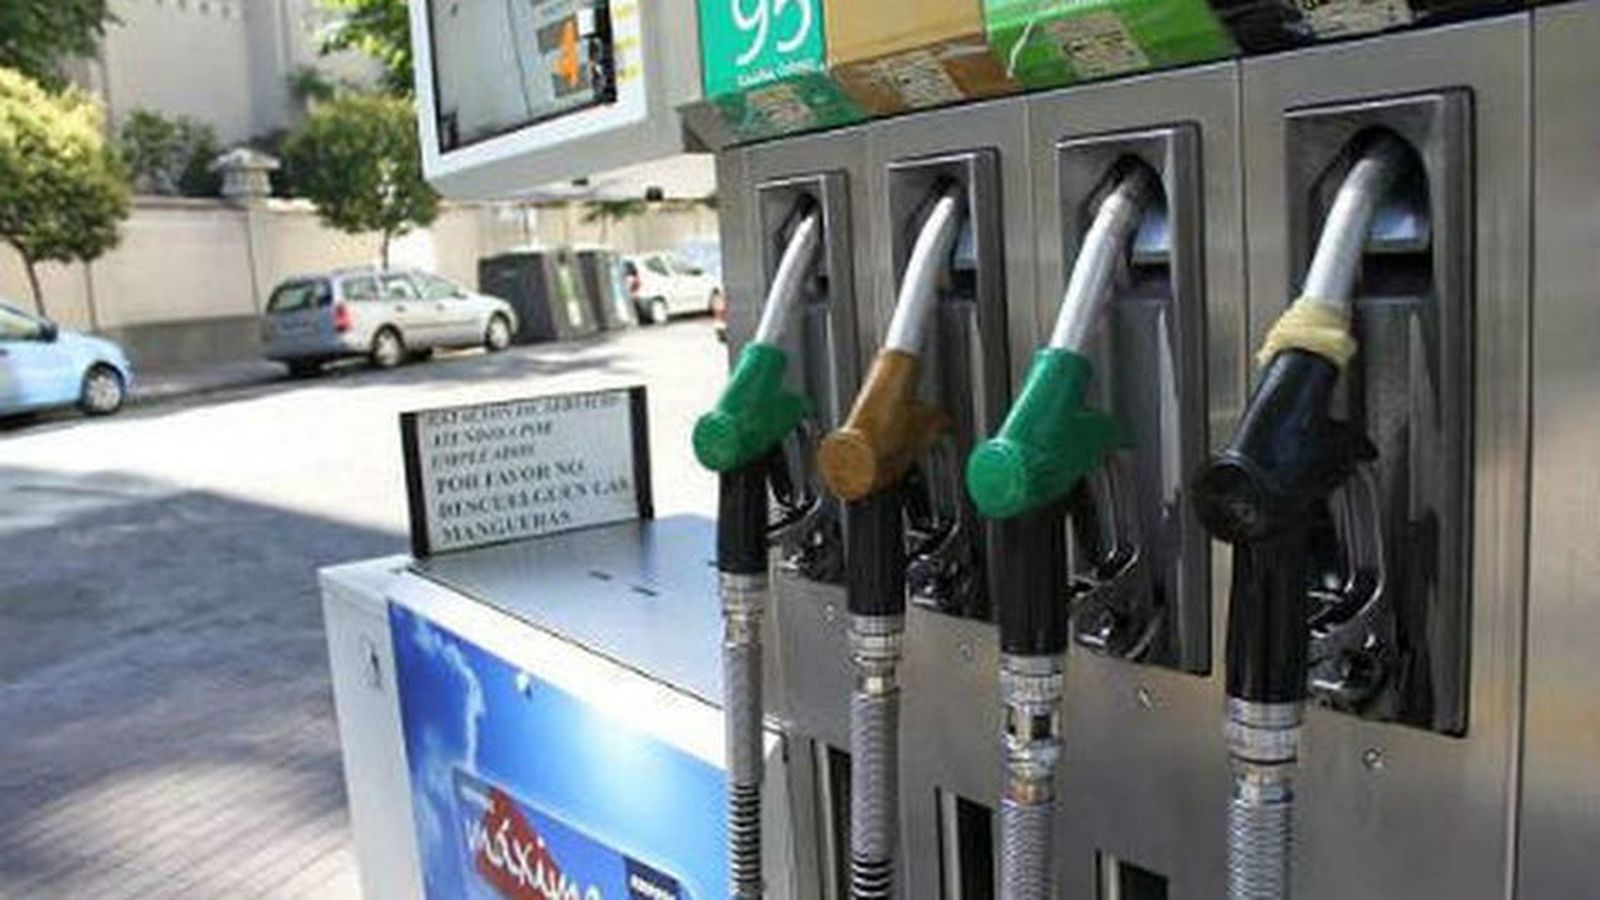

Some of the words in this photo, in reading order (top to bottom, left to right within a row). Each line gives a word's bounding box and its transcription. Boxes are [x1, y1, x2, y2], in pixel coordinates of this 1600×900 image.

[730, 0, 812, 66] 95
[436, 475, 479, 495] POR
[484, 463, 551, 491] FAVOR
[554, 460, 584, 477] NO
[441, 510, 570, 543] MANGUERAS
